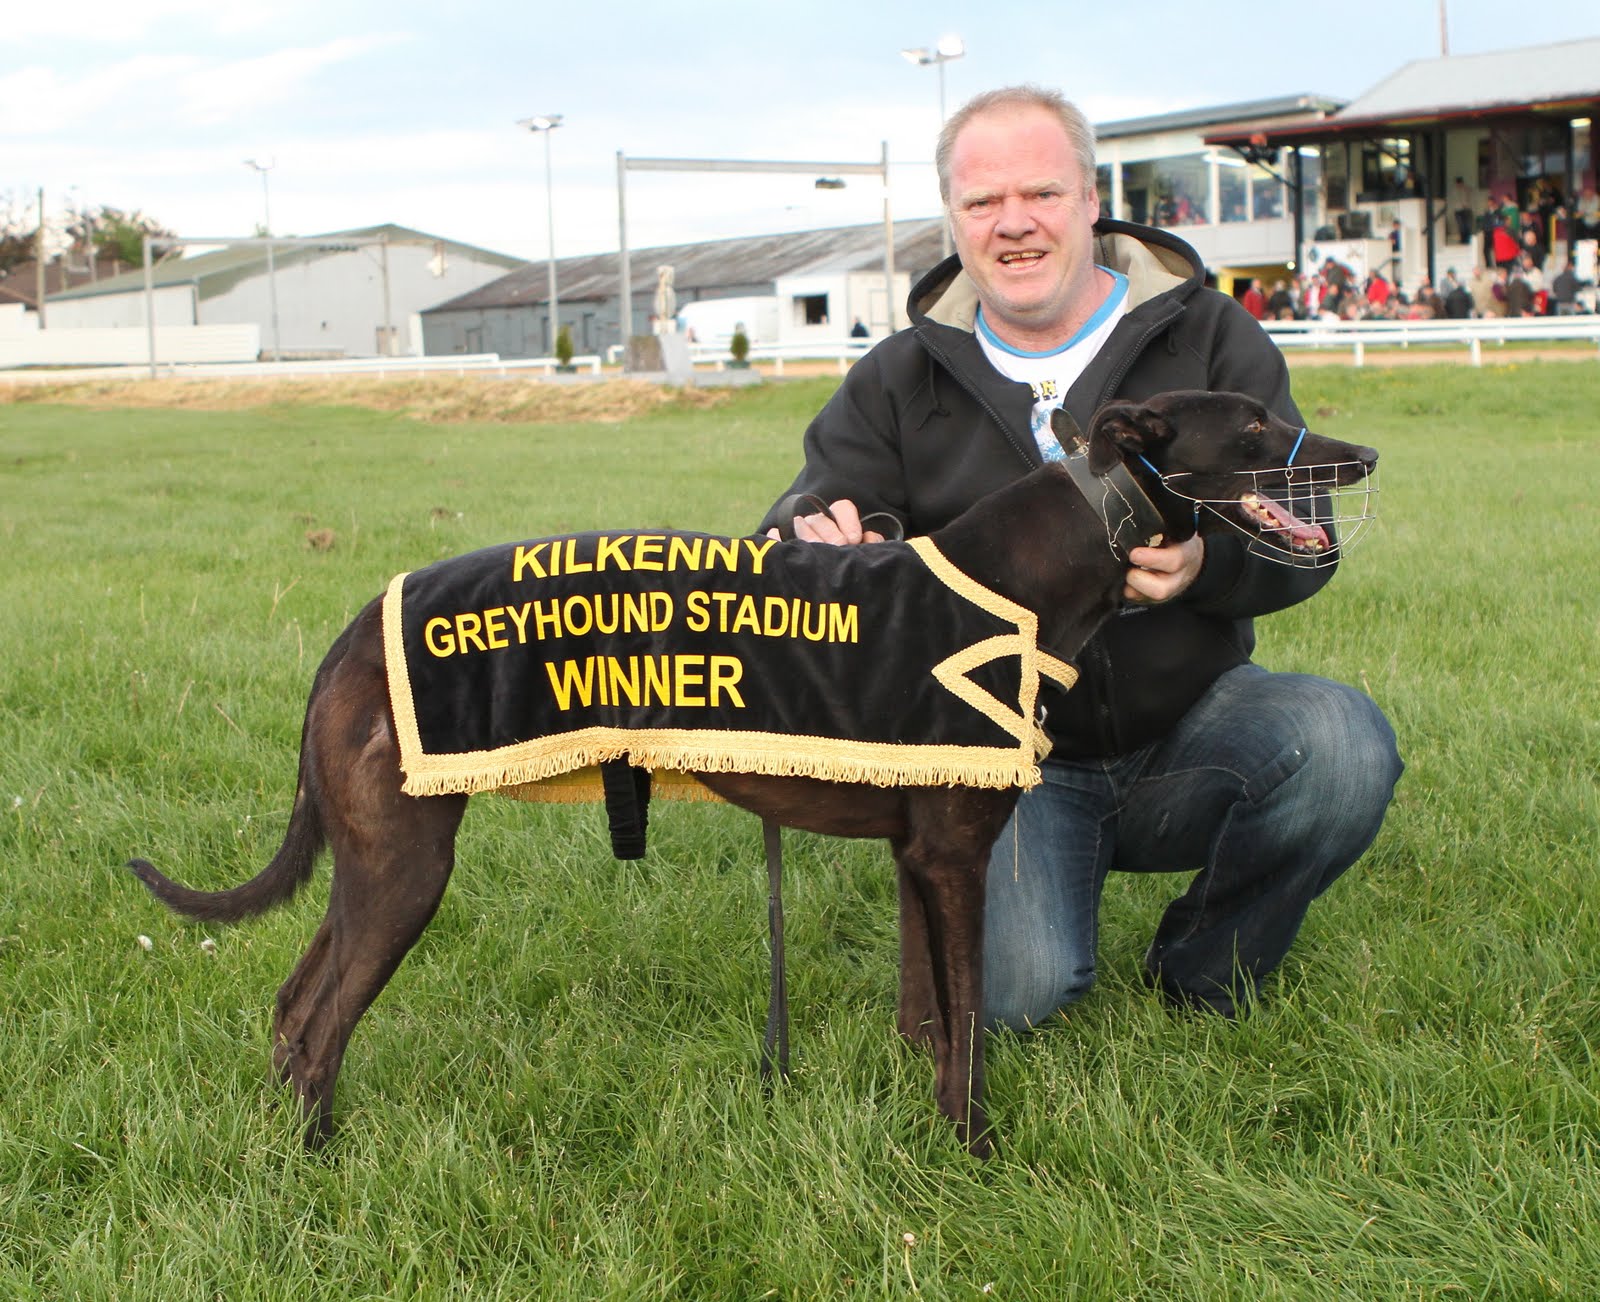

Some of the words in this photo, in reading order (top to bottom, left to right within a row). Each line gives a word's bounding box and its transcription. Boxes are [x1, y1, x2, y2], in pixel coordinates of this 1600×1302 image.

[512, 534, 777, 582] KILKENNY
[424, 591, 674, 658] GREYHOUND
[685, 590, 860, 644] STADIUM
[544, 654, 746, 712] WINNER
